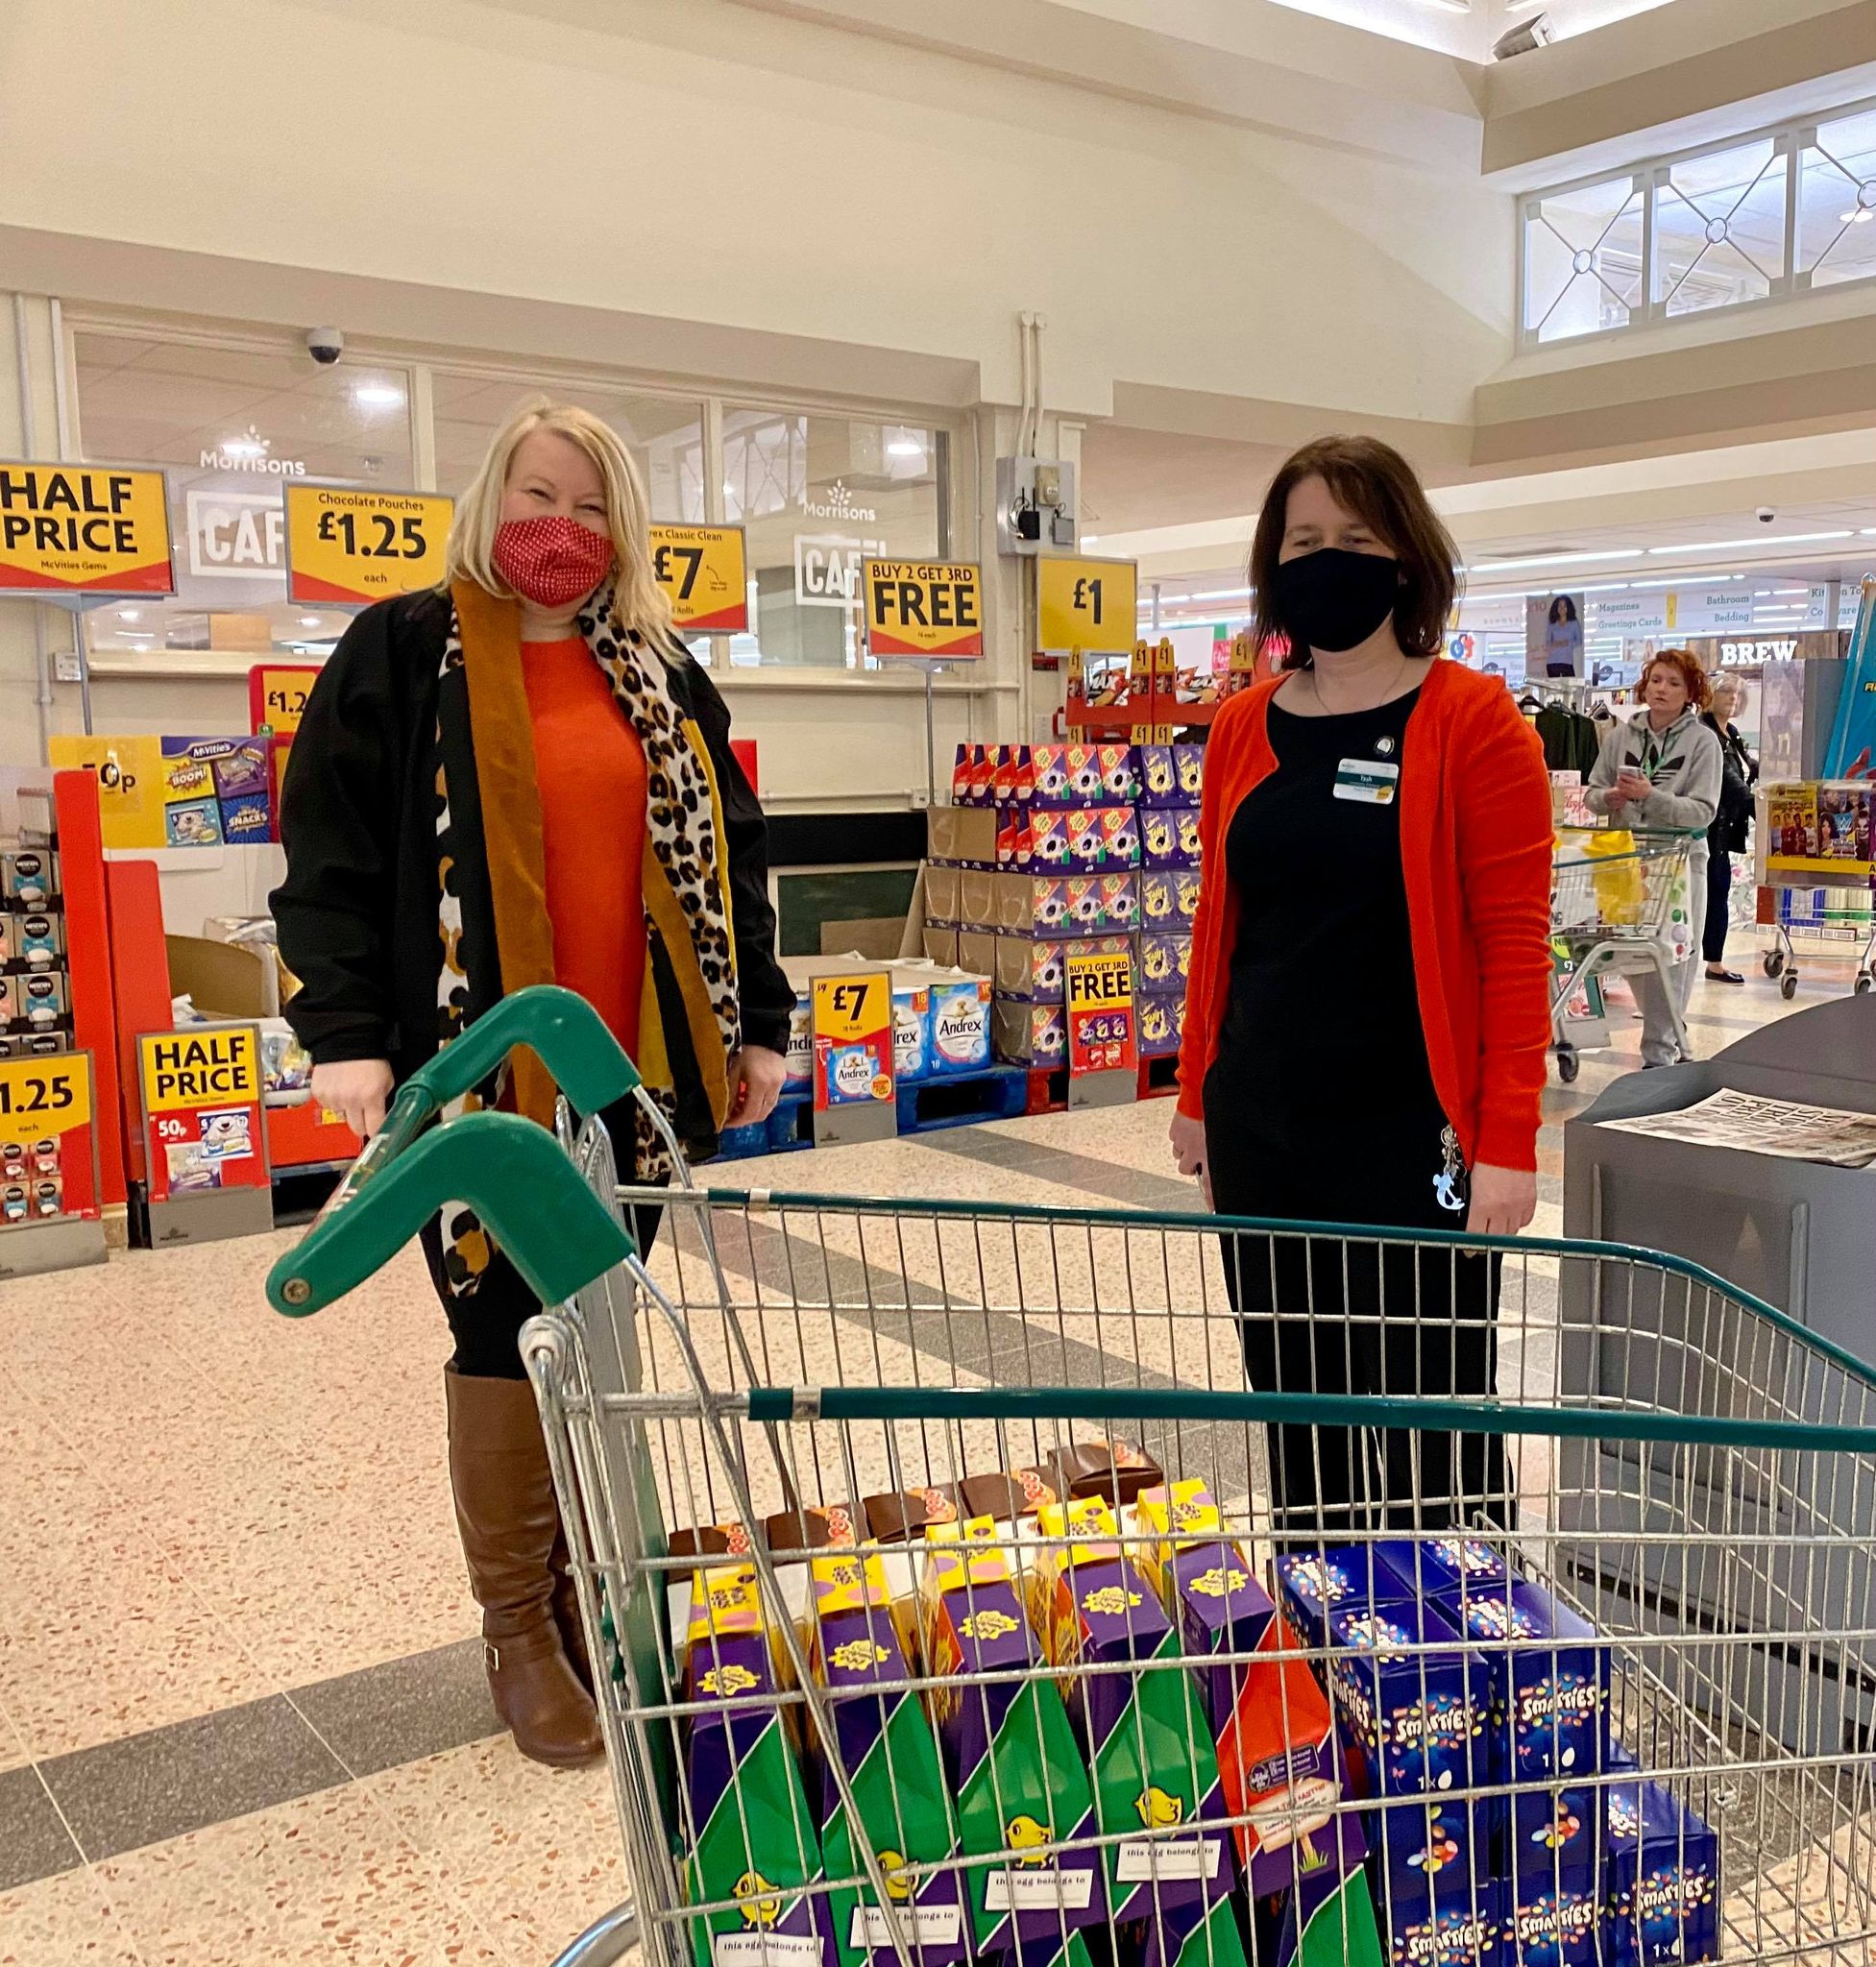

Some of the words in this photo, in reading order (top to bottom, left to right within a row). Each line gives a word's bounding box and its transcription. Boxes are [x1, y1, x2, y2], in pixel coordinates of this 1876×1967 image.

[200, 450, 306, 475] Morrisons
[0, 471, 133, 514] HALF
[318, 493, 376, 508] Chocolate
[378, 498, 424, 511] Pouches
[803, 501, 876, 522] Morrisons
[3, 515, 138, 554] PRICE
[203, 507, 283, 565] CAF
[317, 511, 426, 560] £1.25
[649, 529, 663, 538] rex
[666, 529, 695, 541] Classic
[697, 531, 722, 542] Clean
[363, 572, 387, 583] each
[652, 546, 704, 600] £7
[805, 549, 862, 597] CAF
[872, 564, 902, 579] BUY
[906, 566, 914, 579] 2
[917, 567, 943, 581] GET
[948, 568, 973, 582] 3RD
[873, 581, 977, 627] FREE
[1073, 578, 1102, 624] £1
[1598, 602, 1640, 613] Magazines
[1706, 595, 1749, 605] Bathroom
[1597, 619, 1637, 630] Greetings
[1638, 617, 1663, 627] Cards
[1714, 612, 1749, 623] Bedding
[1136, 648, 1146, 667] £1
[1159, 647, 1169, 666] £1
[1720, 641, 1797, 666] BREW
[268, 691, 306, 714] £1.2
[1136, 726, 1146, 743] £1
[1158, 726, 1167, 743] £1
[1069, 964, 1085, 974] BUY
[1088, 963, 1093, 972] 2
[1095, 962, 1109, 972] GET
[1113, 960, 1128, 970] 3RD
[1070, 970, 1131, 1002] FREE
[833, 984, 868, 1021] £7
[916, 992, 927, 1004] 18
[939, 1018, 982, 1035] Andrex
[894, 1031, 917, 1044] rex
[154, 1035, 245, 1071] HALF
[157, 1066, 249, 1099] PRICE
[838, 1067, 869, 1081] Andrex
[158, 1119, 187, 1137] 50p
[1127, 1849, 1145, 1858] this
[724, 1940, 743, 1951] this
